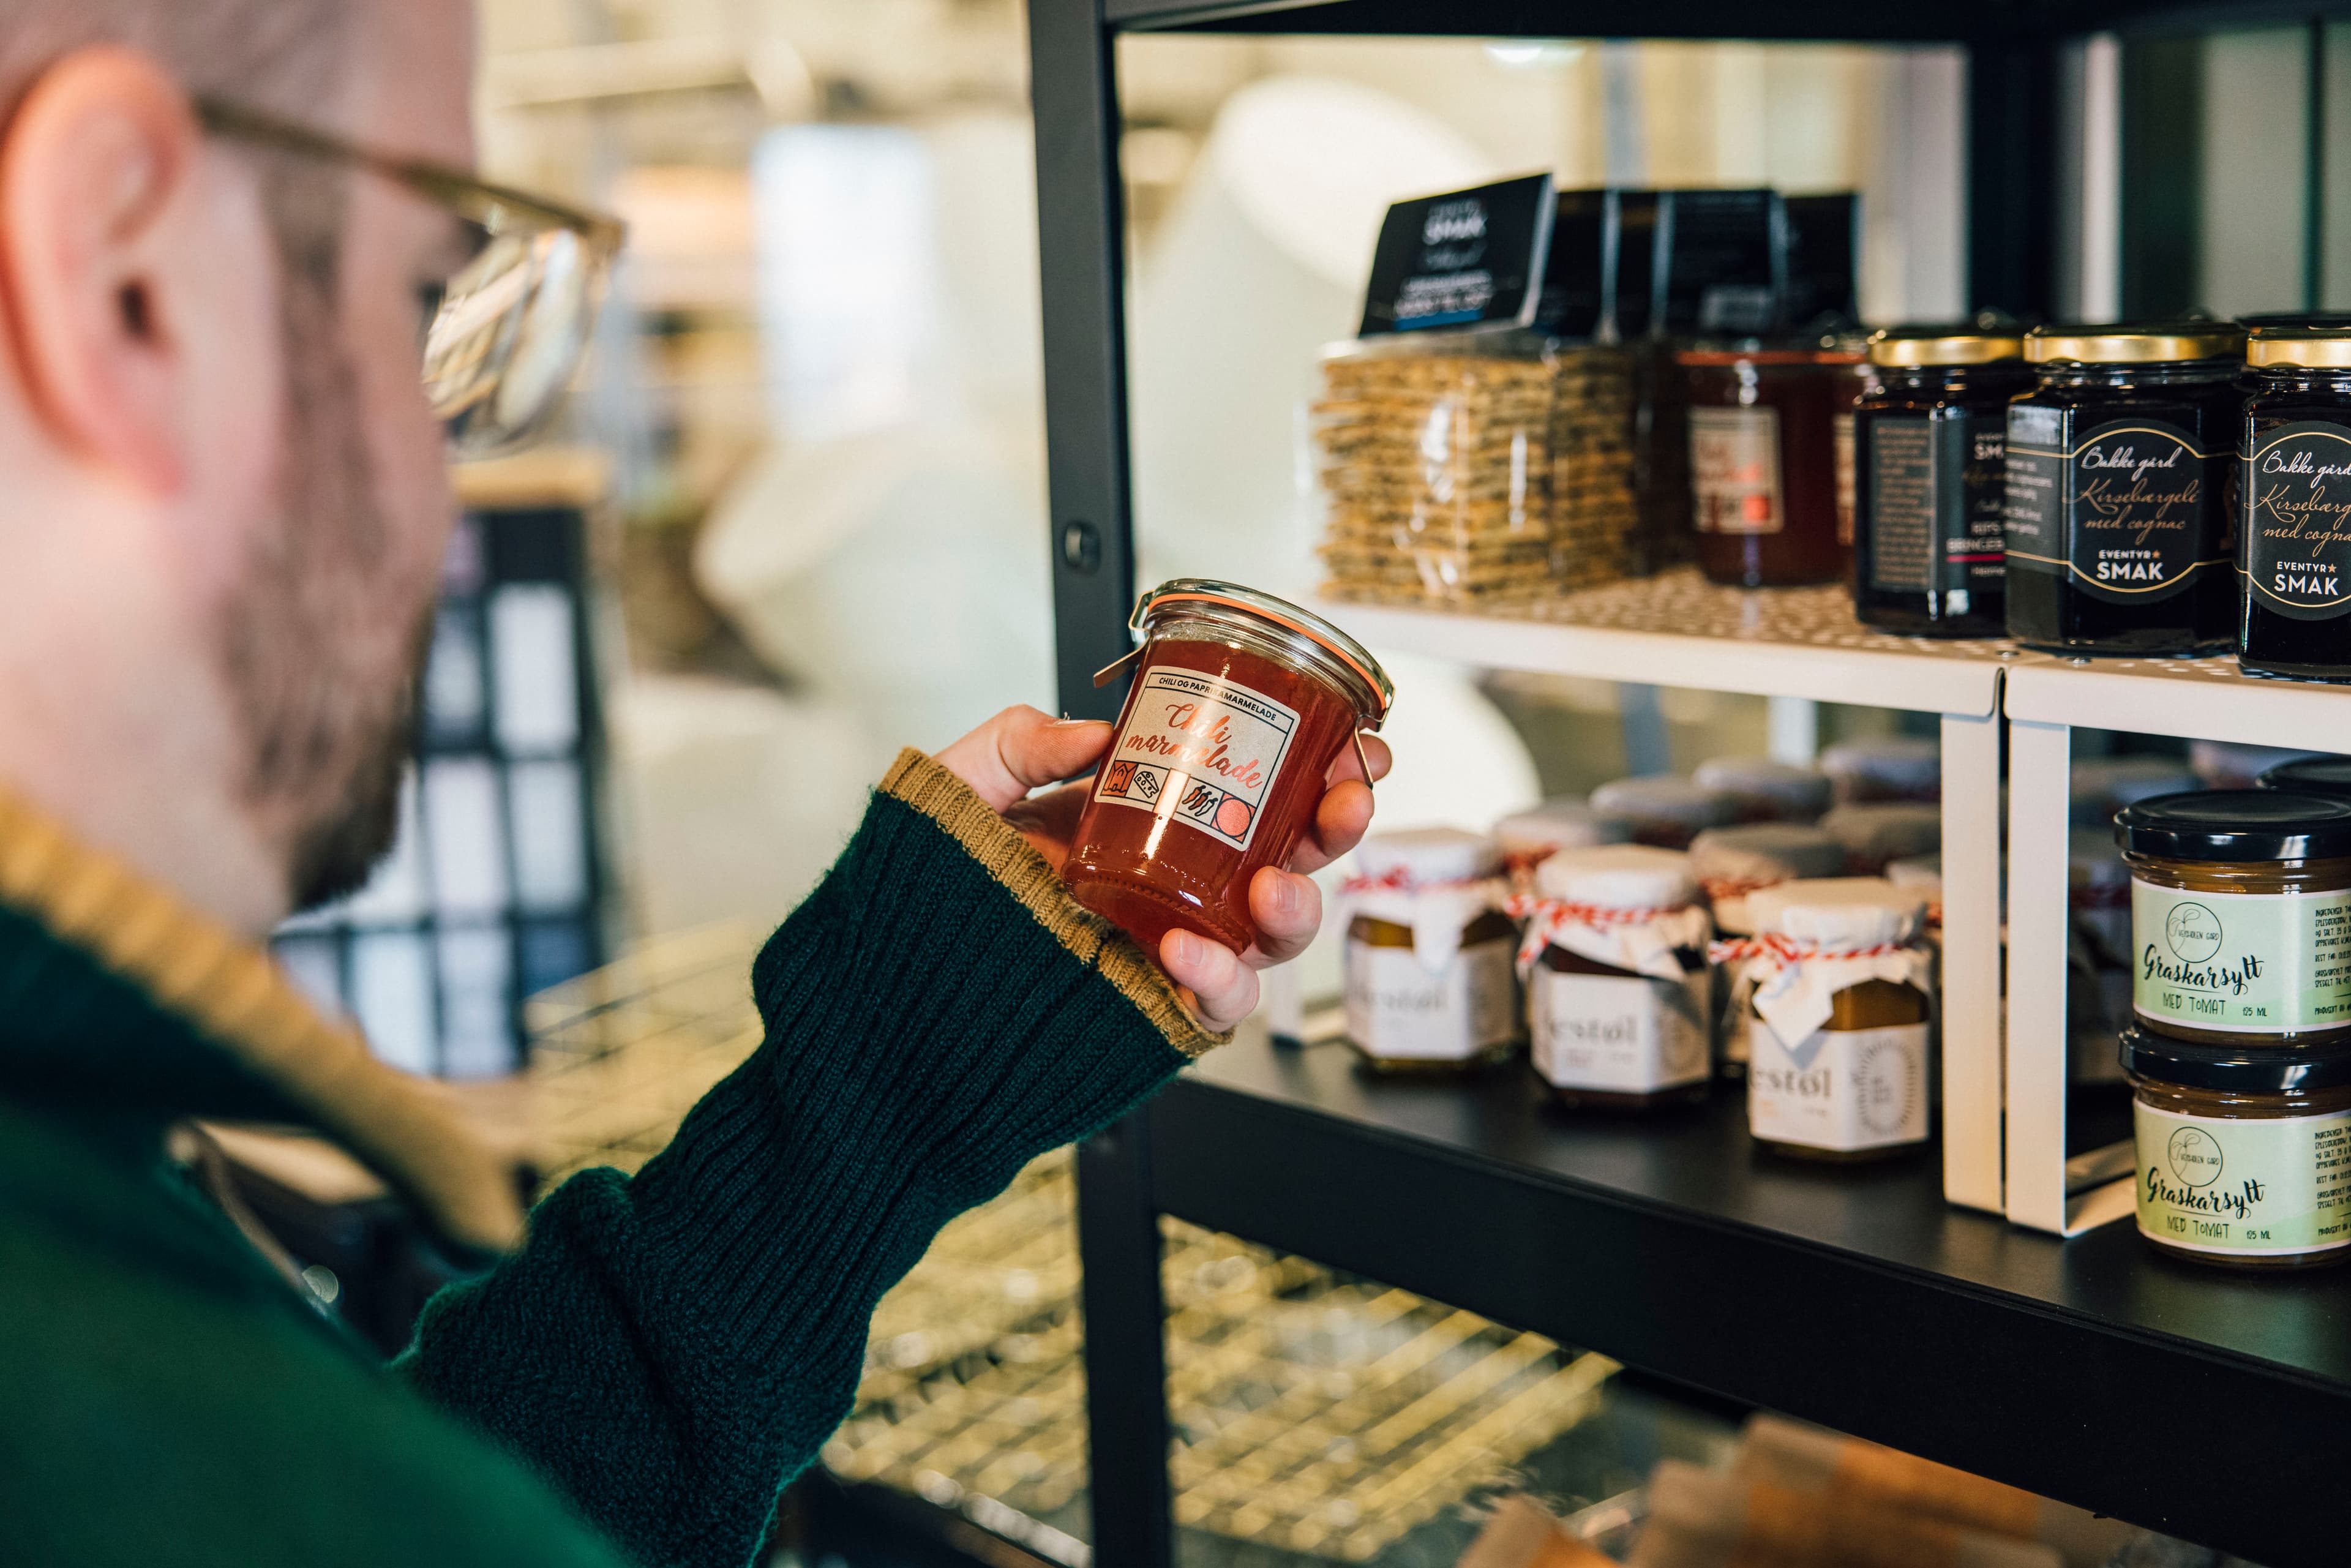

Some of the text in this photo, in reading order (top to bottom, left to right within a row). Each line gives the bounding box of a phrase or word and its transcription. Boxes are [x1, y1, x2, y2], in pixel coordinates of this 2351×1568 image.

[2081, 446, 2183, 481] Bakke gård
[2262, 450, 2314, 473] Bakke
[2083, 504, 2186, 546] med cognac
[2262, 514, 2309, 539] med
[2098, 550, 2151, 559] EVENTYR
[2096, 561, 2164, 580] SMAK
[2276, 561, 2327, 573] EVENTYR
[2274, 574, 2339, 596] SMAK
[1159, 677, 1176, 686] CHILI
[1190, 683, 1277, 721] PAPRIKAMARMELADE
[1166, 703, 1232, 744] Chili
[1125, 734, 1262, 789] marmelade
[2162, 992, 2182, 1009] MED
[2243, 1007, 2267, 1016] 125 ML
[2167, 1215, 2186, 1232] MED
[2246, 1230, 2271, 1239] 125 ML
